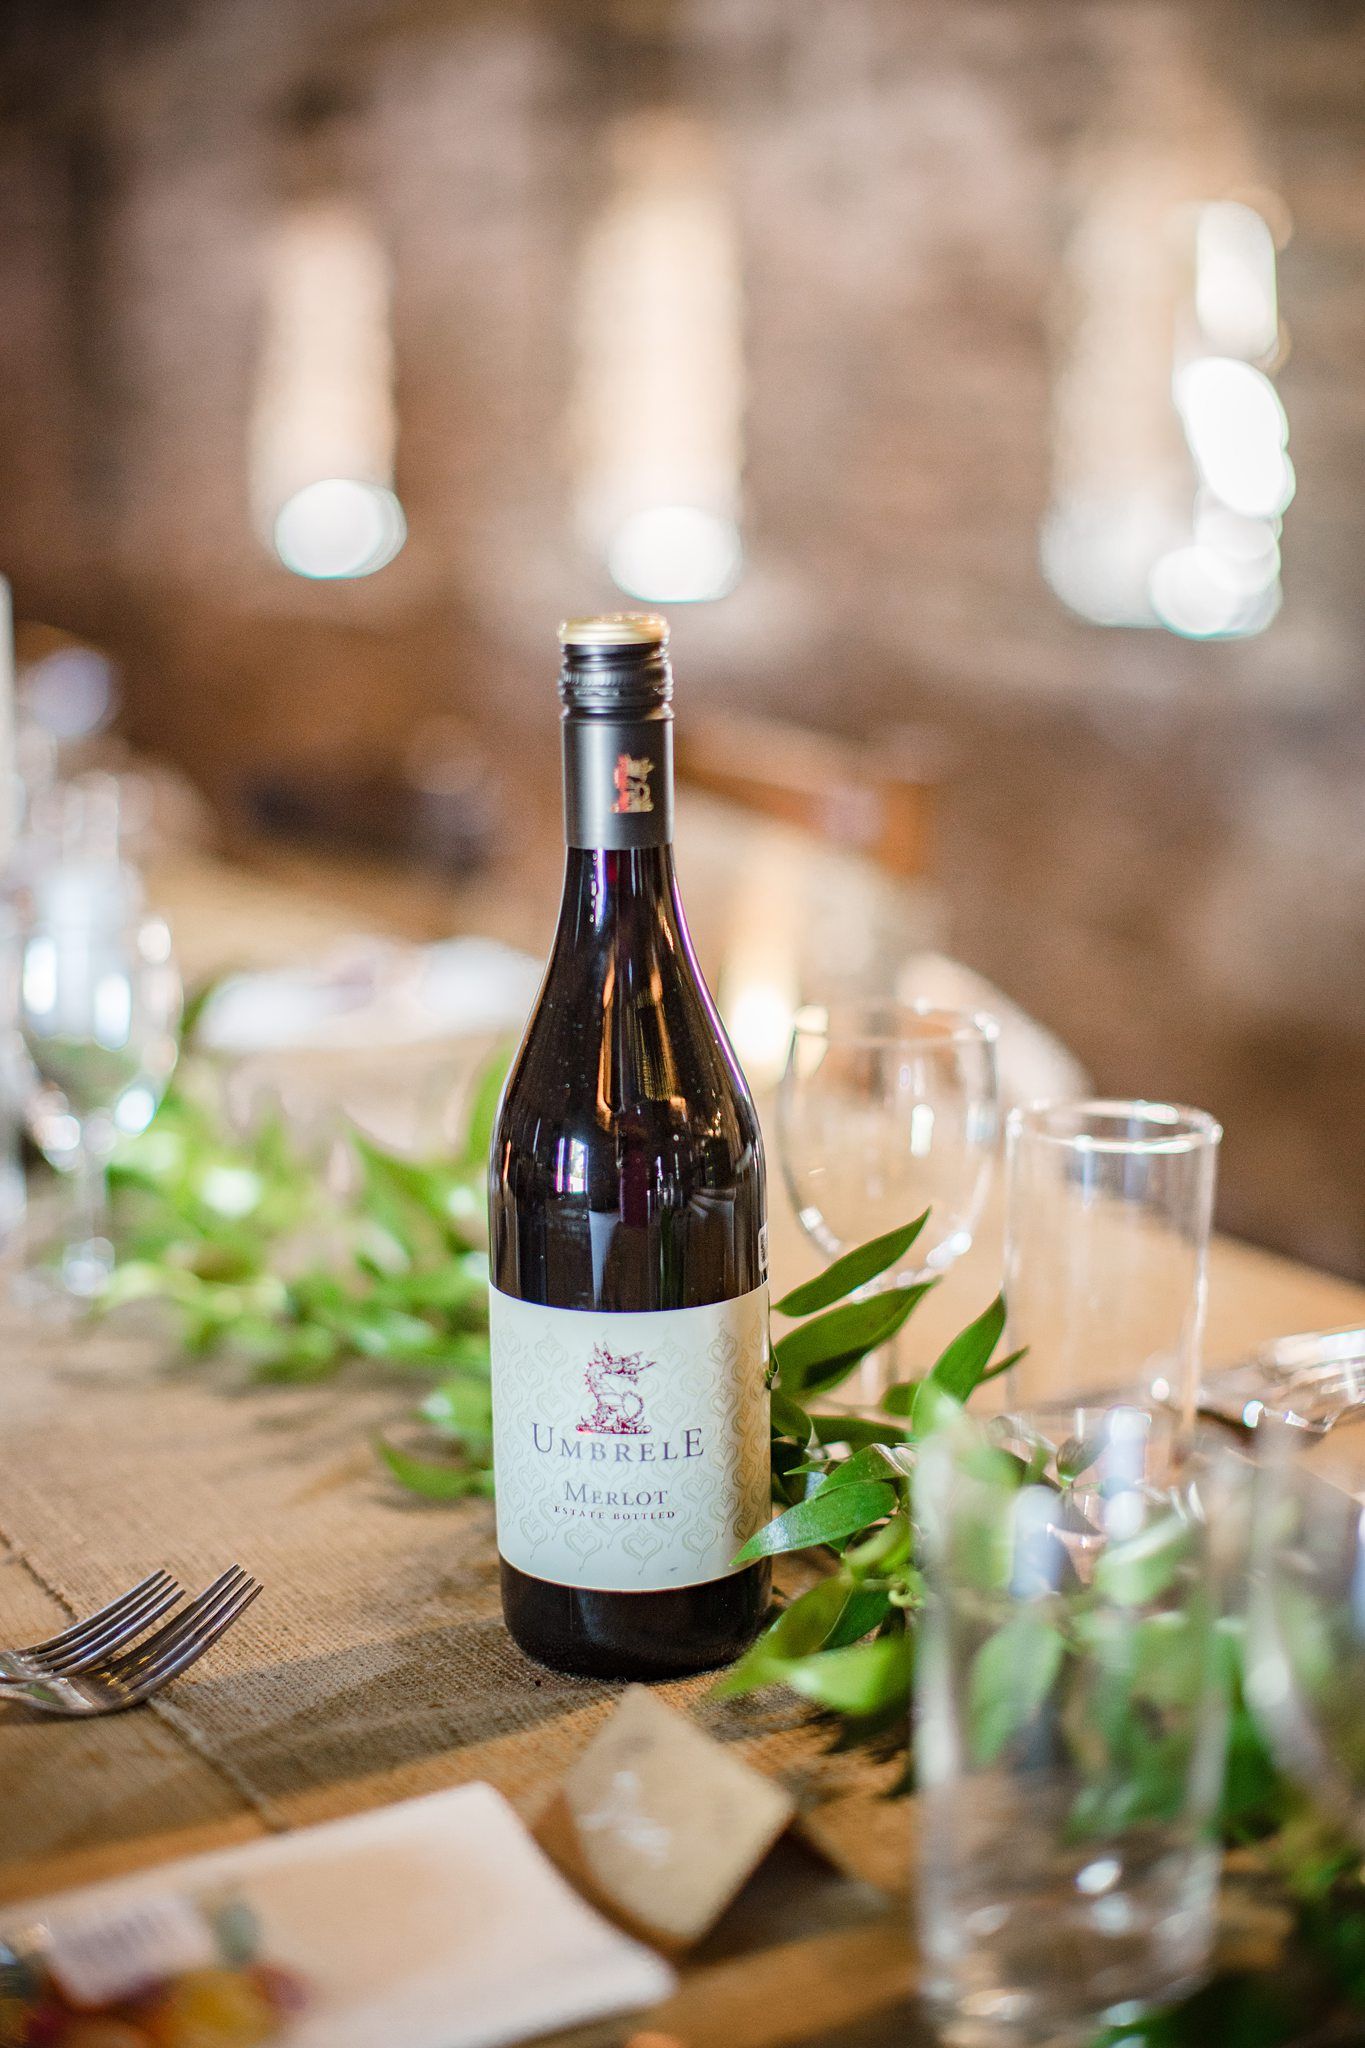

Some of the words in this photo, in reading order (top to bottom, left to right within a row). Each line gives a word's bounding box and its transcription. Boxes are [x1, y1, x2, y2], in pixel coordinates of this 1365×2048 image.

[532, 1422, 704, 1462] UMBRELE
[565, 1481, 668, 1505] MERLOT
[554, 1505, 605, 1520] ESTATE
[613, 1511, 676, 1521] BOTTLED
